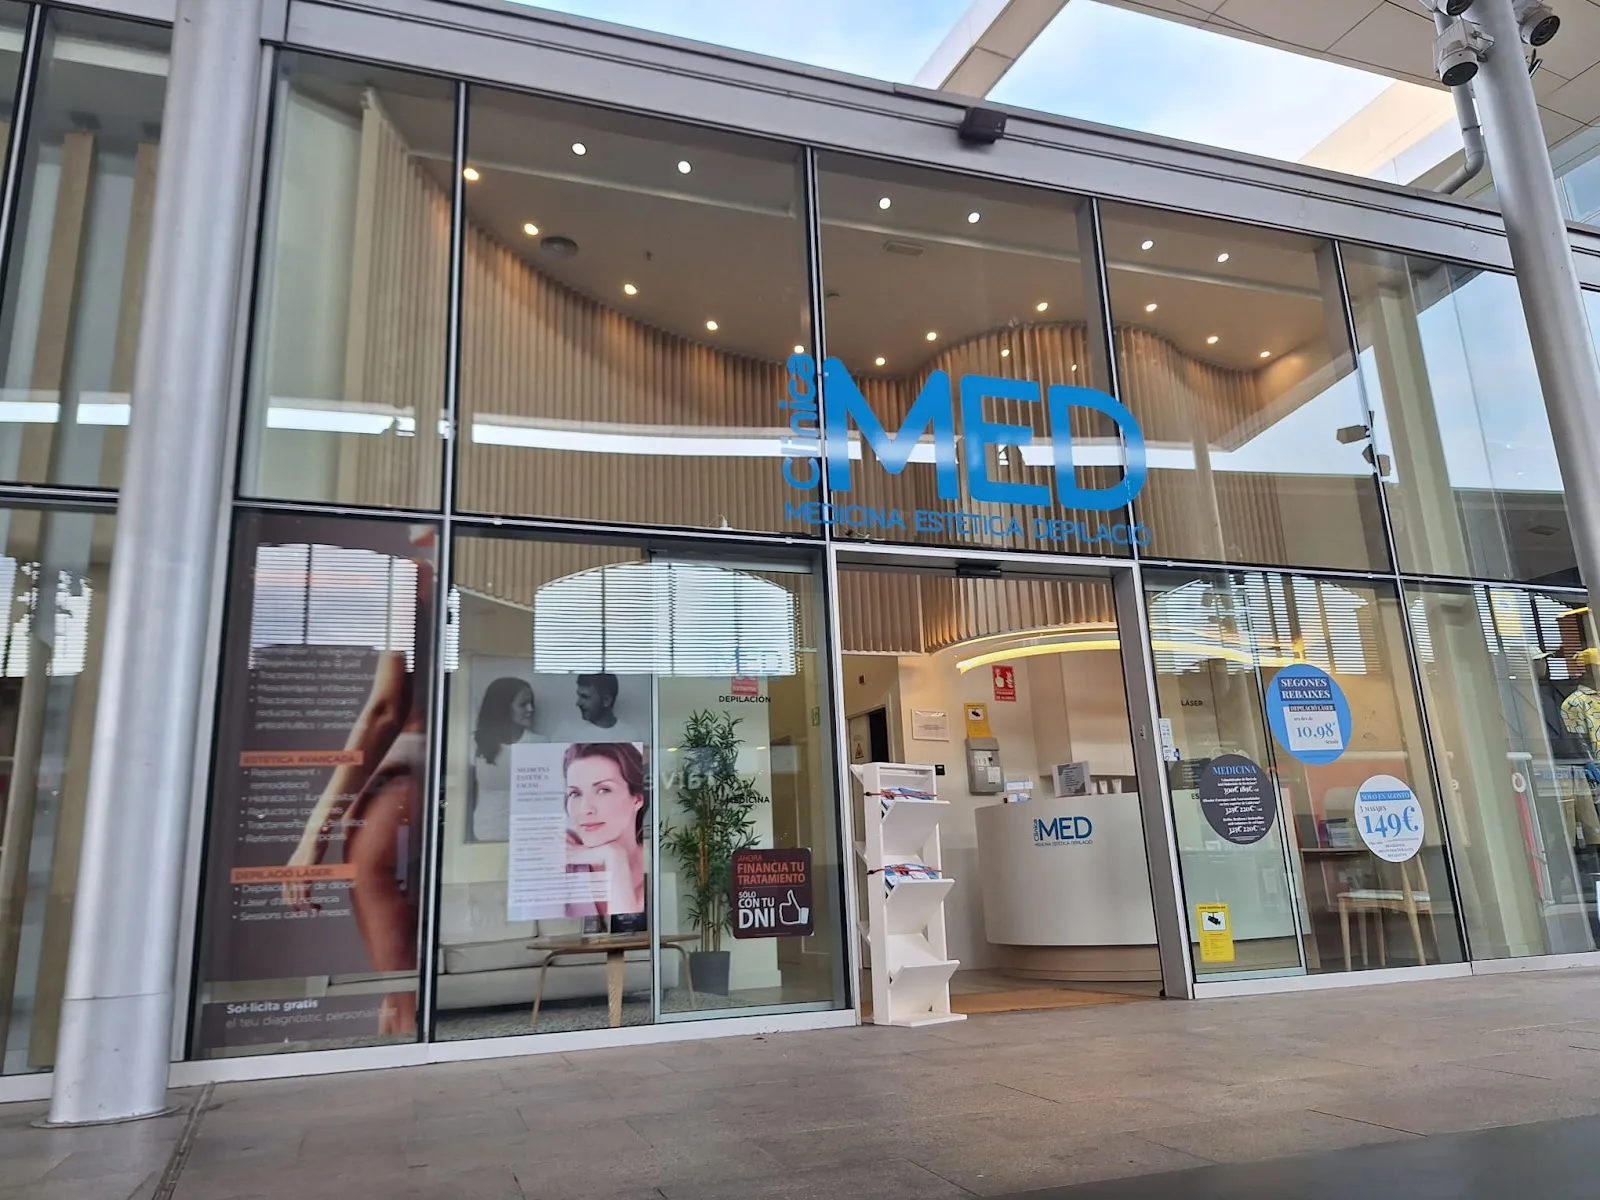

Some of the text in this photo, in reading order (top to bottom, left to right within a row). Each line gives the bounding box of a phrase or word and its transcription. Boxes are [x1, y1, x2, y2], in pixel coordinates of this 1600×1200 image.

[823, 355, 1147, 511] MED
[784, 501, 906, 530] MEDICINA
[1033, 518, 1151, 547] DEPILACIÓ
[1280, 678, 1328, 688] SEGONES
[718, 695, 772, 703] DEPILACIÓN
[1281, 689, 1331, 700] REBAIXES
[1212, 765, 1257, 775] MEDICINA
[1362, 805, 1419, 838] 149€
[1038, 816, 1093, 841] MED
[738, 854, 762, 862] AHORA
[737, 861, 805, 874] FINANCIA TU
[737, 873, 806, 885] TRATAMIENTO
[738, 897, 775, 909] CON TU
[738, 908, 776, 929] DNI
[283, 998, 318, 1012] gratis
